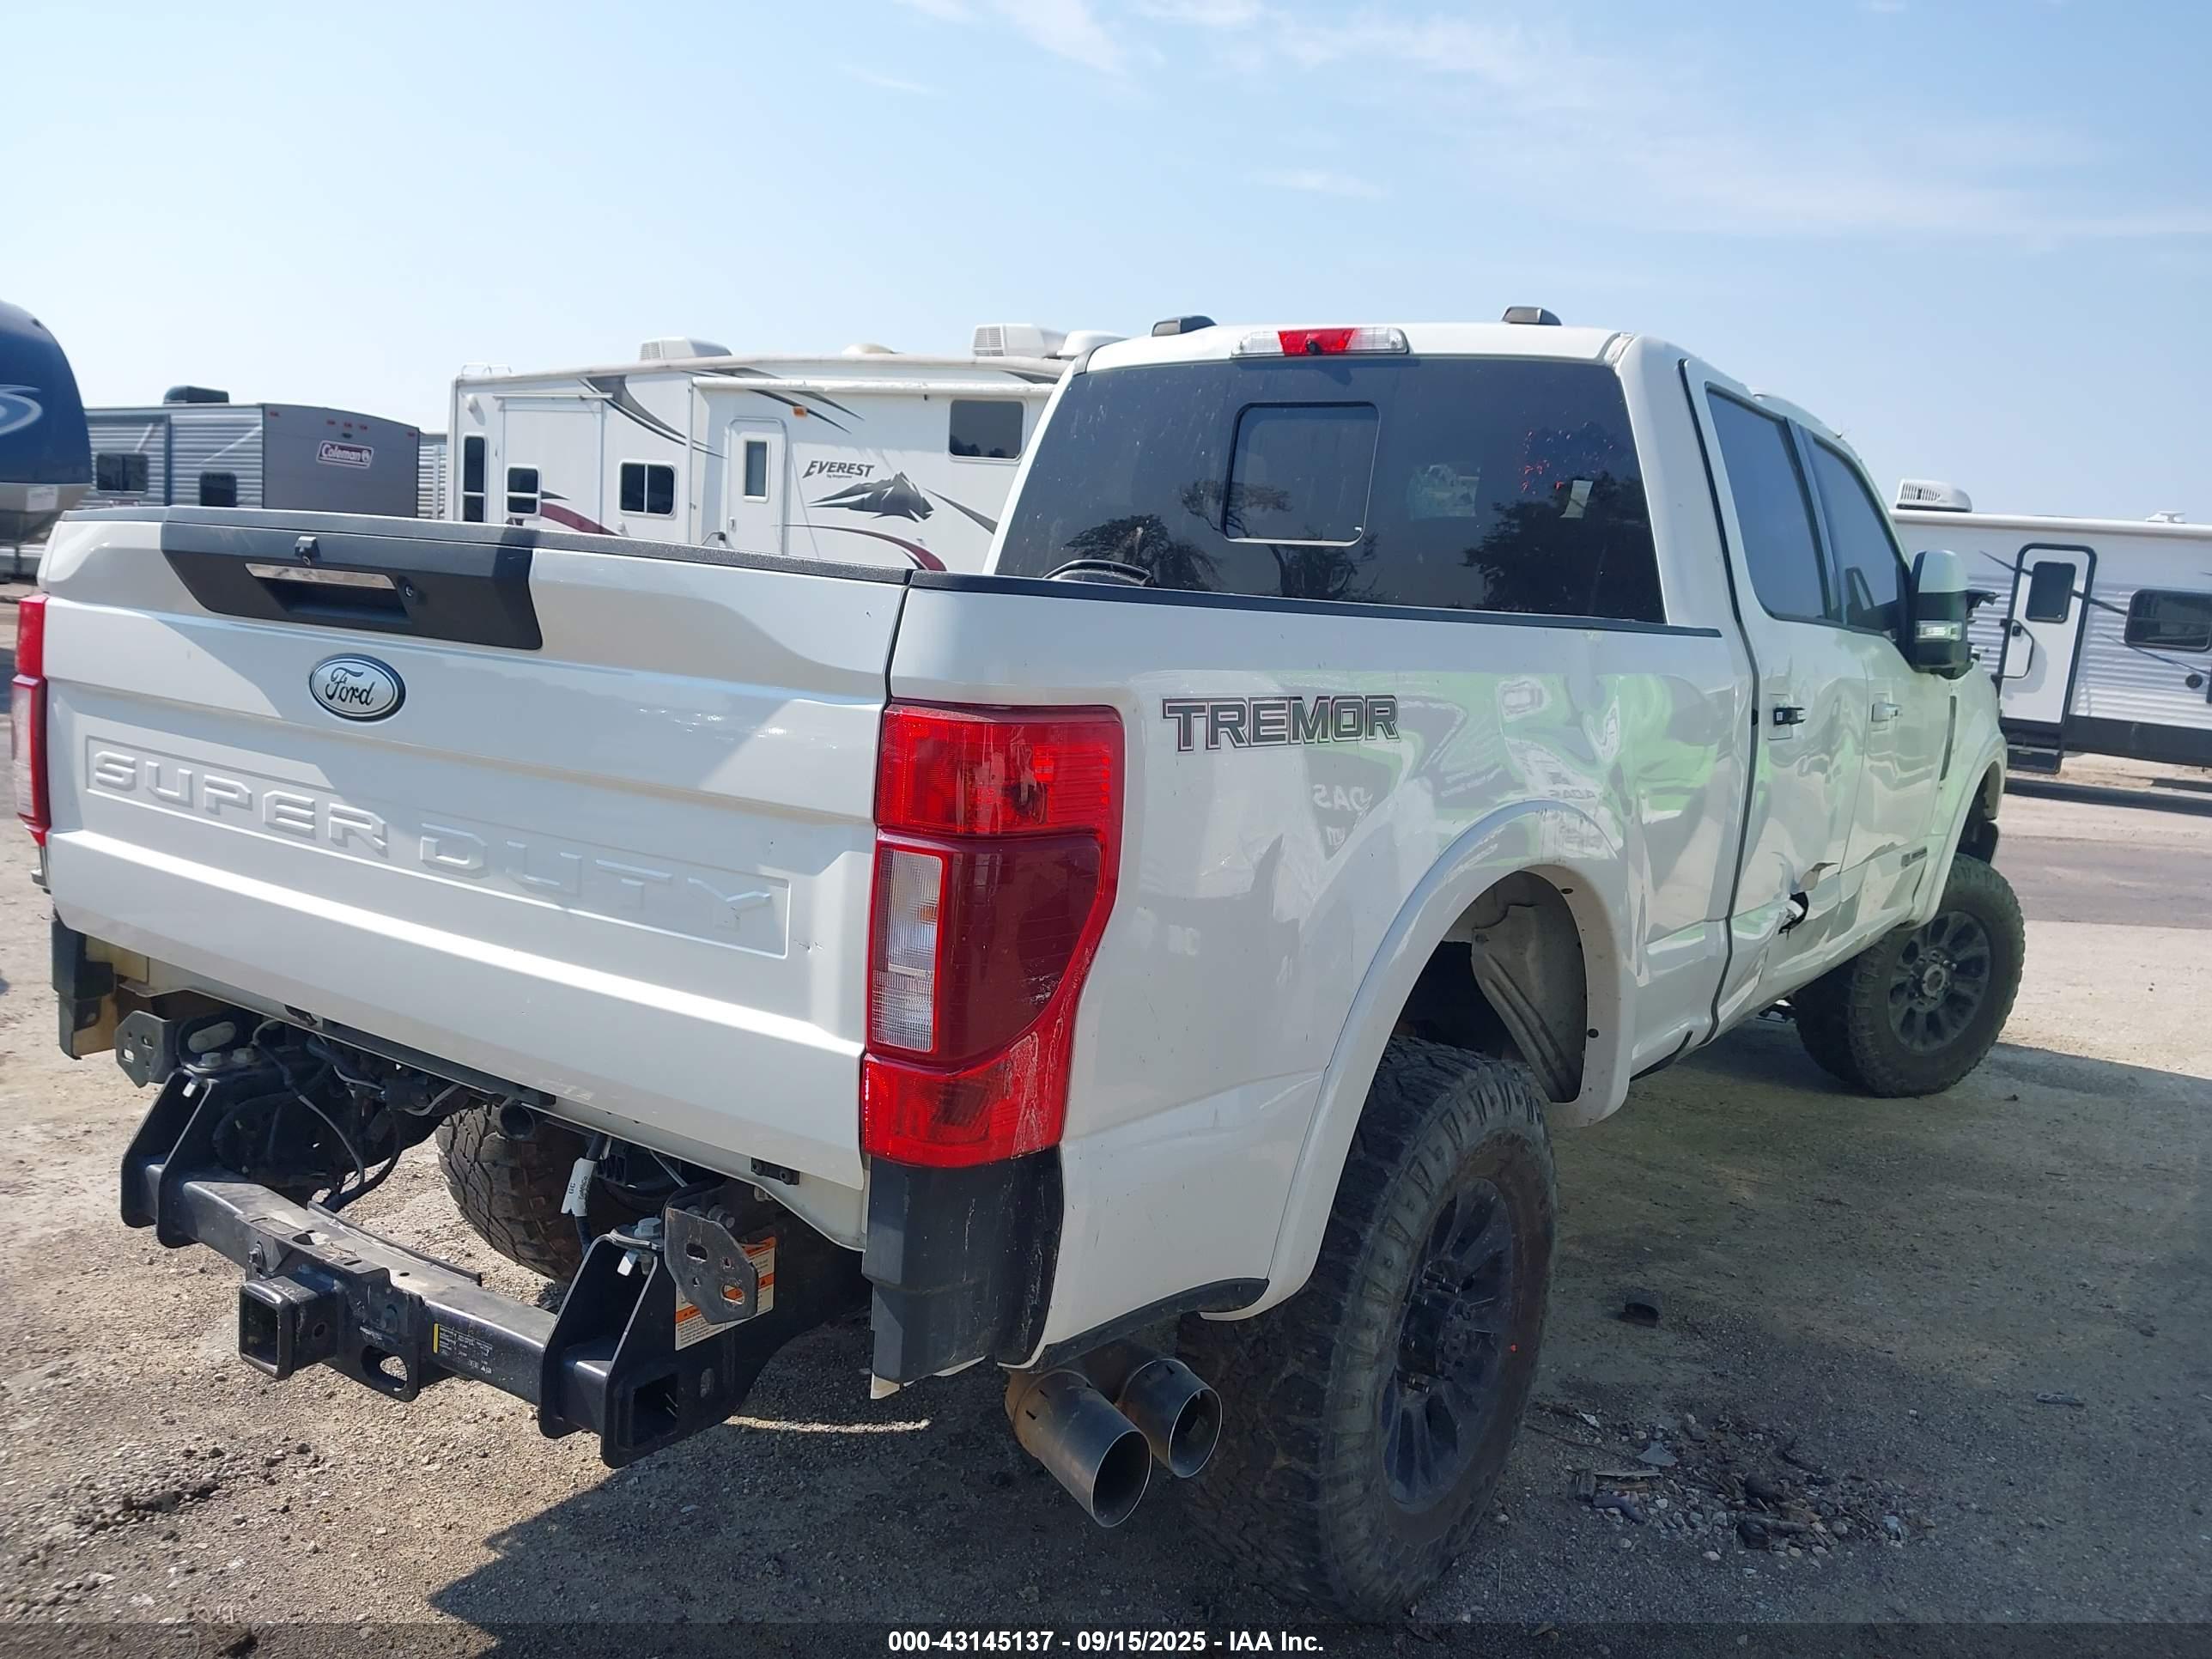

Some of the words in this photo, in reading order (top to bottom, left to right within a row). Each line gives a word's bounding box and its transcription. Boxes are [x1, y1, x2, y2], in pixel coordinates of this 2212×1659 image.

[322, 444, 361, 461] Coleman
[802, 460, 875, 477] EVEREST
[325, 667, 375, 706] Ford
[1162, 695, 1401, 752] TREMOR
[94, 751, 388, 859] SUPER
[420, 822, 771, 932] DUTY
